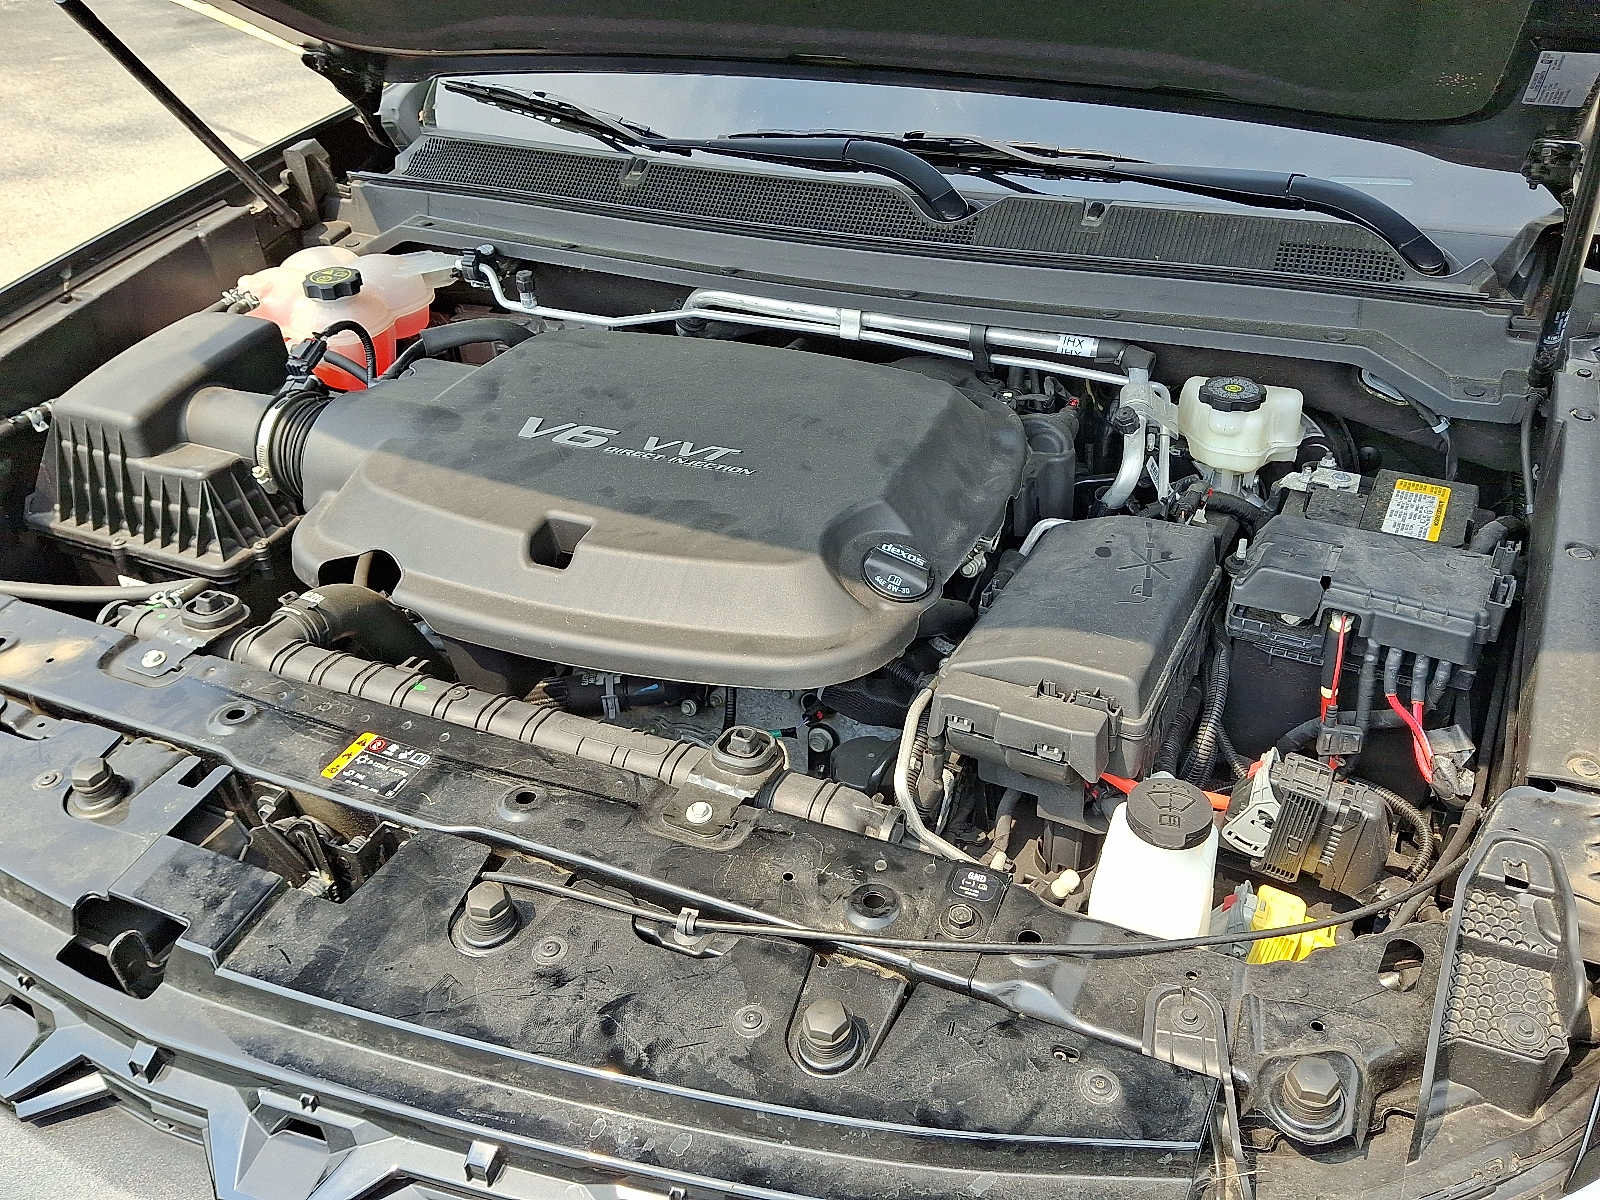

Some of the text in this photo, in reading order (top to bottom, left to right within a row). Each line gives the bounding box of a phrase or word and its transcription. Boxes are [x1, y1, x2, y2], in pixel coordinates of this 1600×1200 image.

[518, 416, 744, 462] V6 VVT
[602, 445, 758, 477] DIRECT INJECTION
[881, 543, 927, 567] dexos
